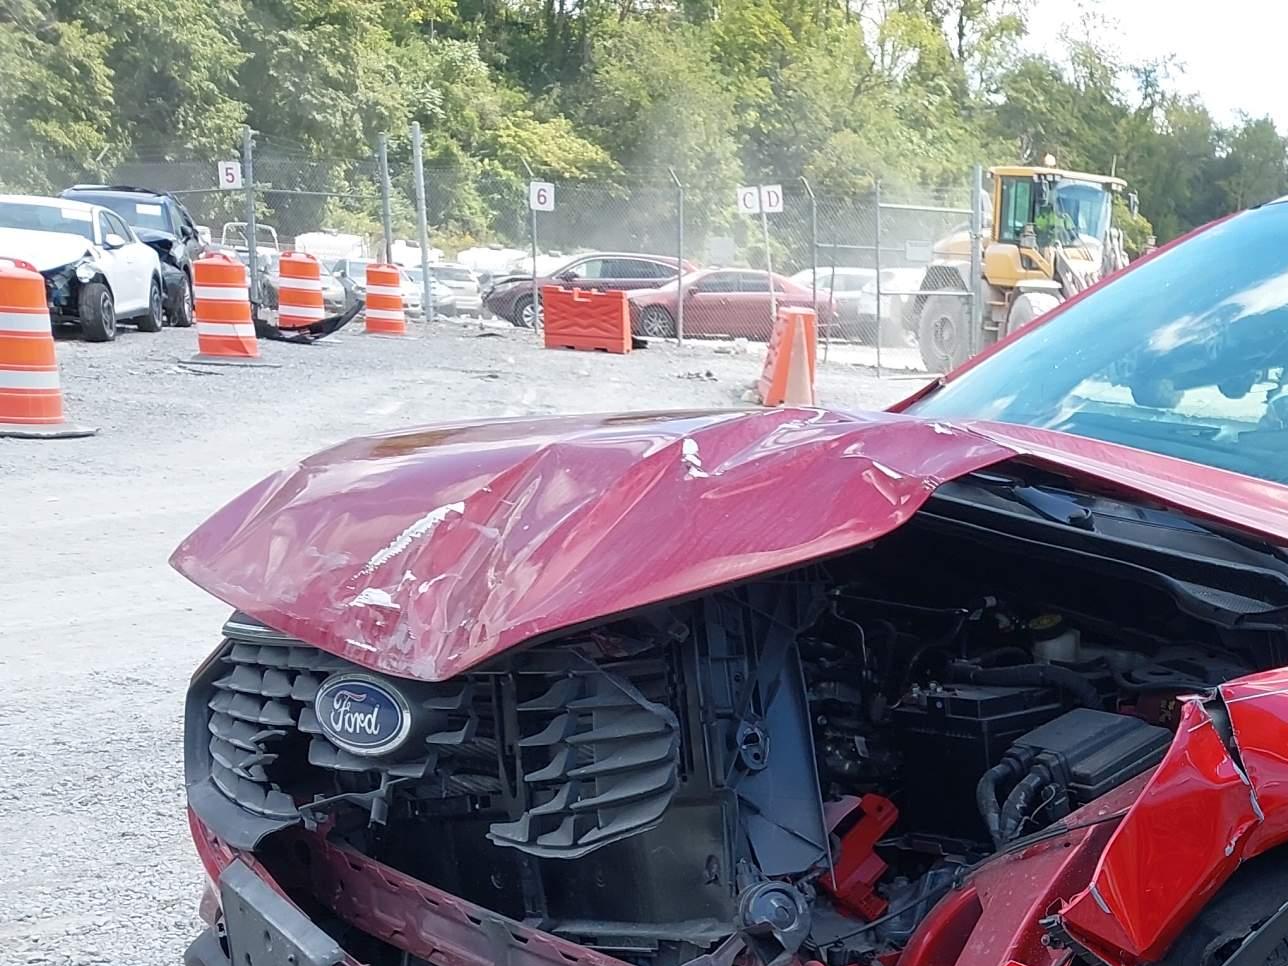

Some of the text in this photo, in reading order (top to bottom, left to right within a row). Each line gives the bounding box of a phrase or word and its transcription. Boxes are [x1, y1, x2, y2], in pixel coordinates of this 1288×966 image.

[225, 167, 235, 183] 5
[537, 188, 547, 205] 6
[743, 191, 754, 209] C
[767, 190, 780, 207] D
[330, 690, 380, 735] Ford
